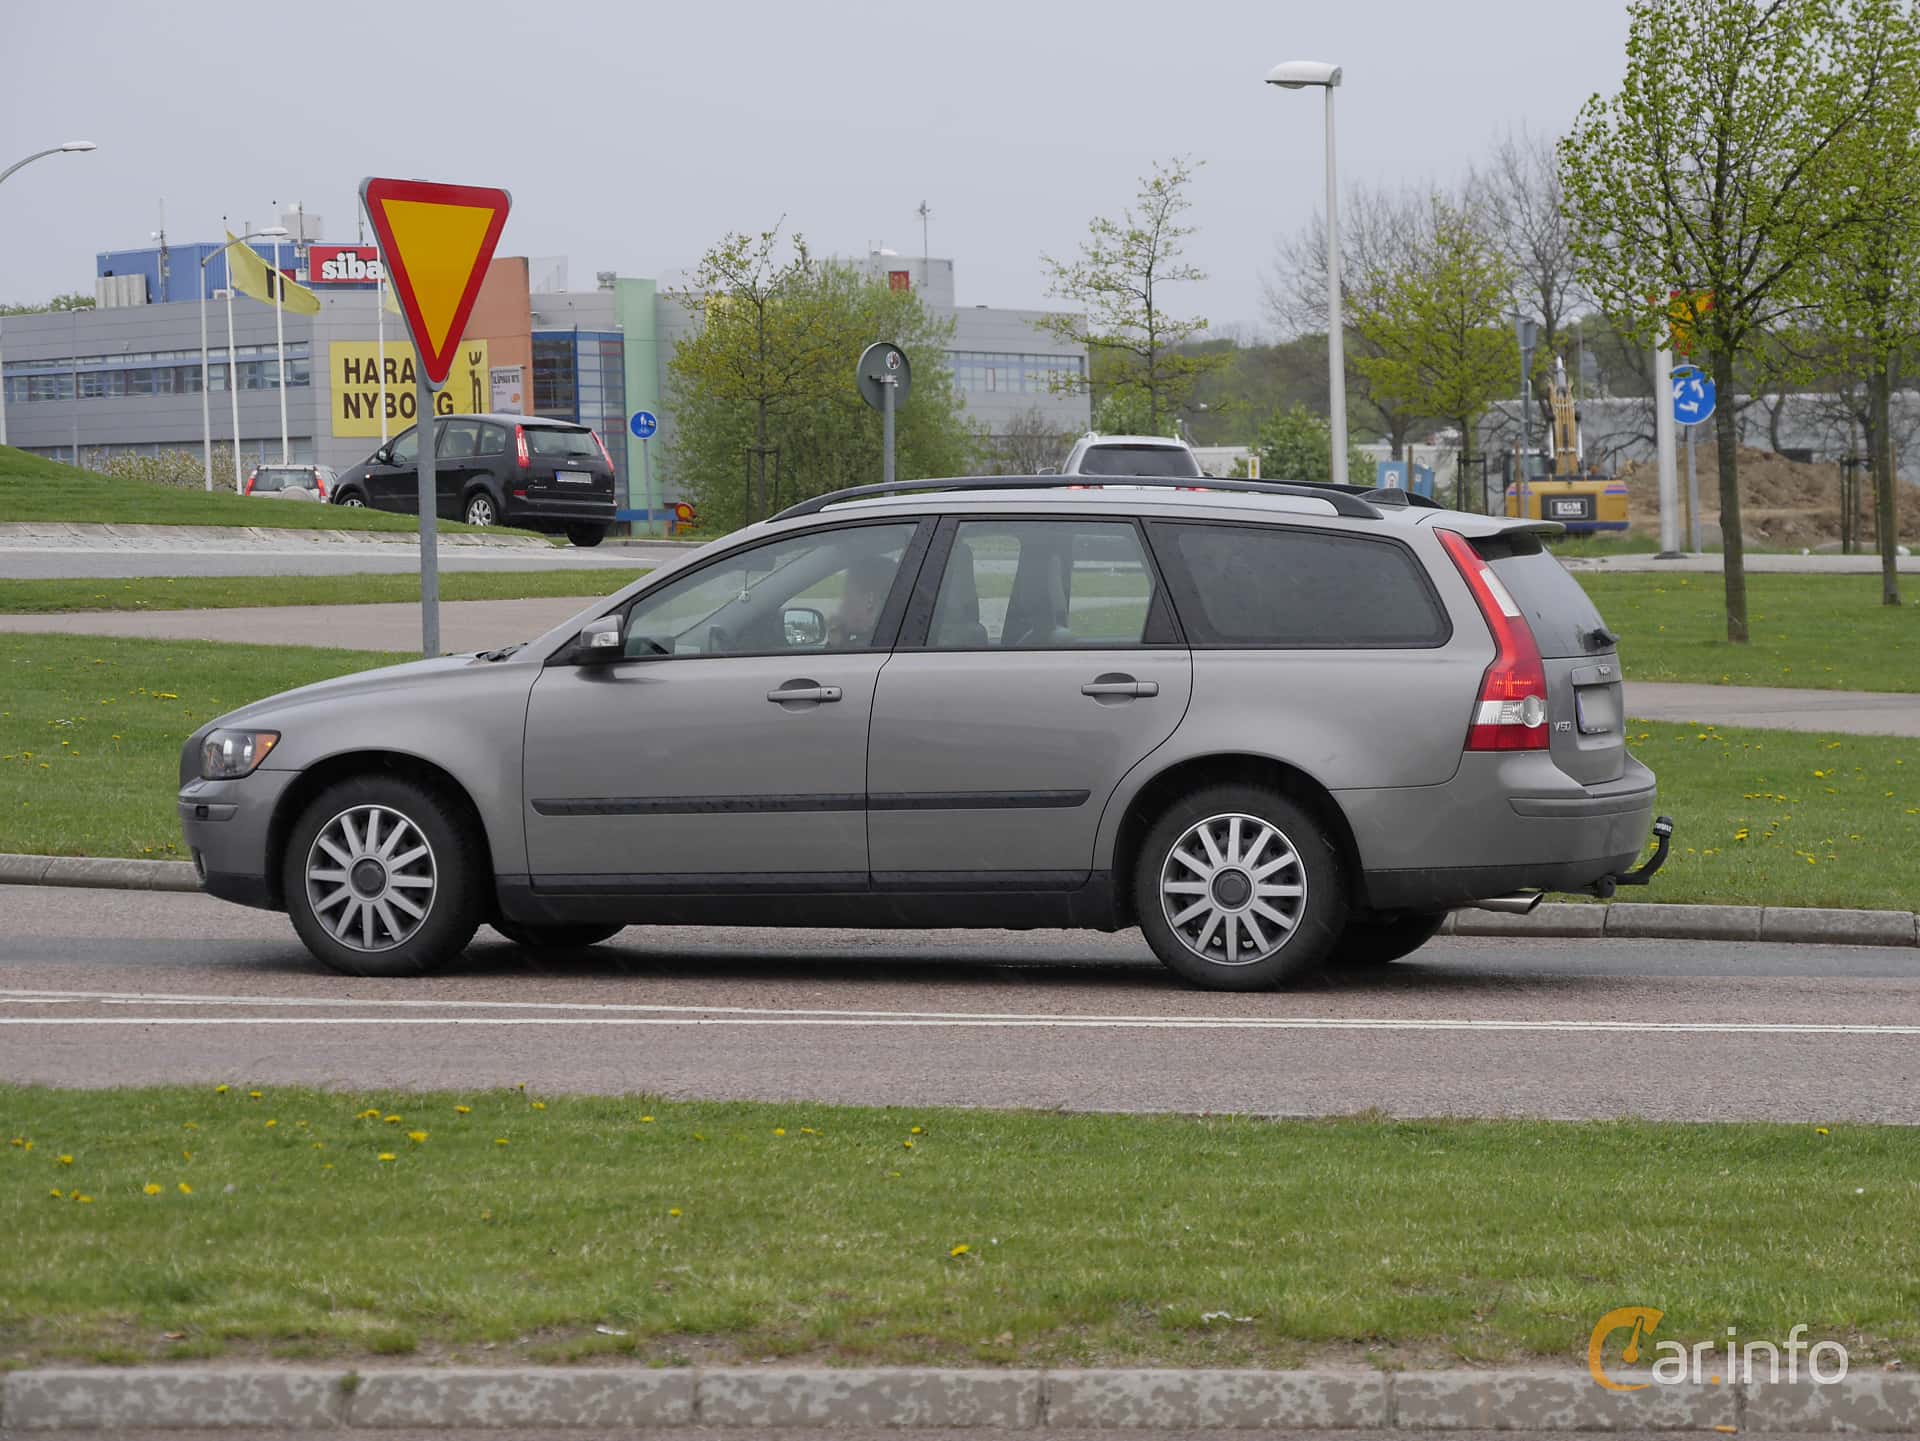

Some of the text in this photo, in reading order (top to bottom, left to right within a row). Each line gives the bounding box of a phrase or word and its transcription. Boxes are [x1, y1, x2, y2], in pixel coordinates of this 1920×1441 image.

[321, 252, 385, 280] siba
[343, 357, 450, 384] HARA
[343, 392, 454, 419] NYBOG
